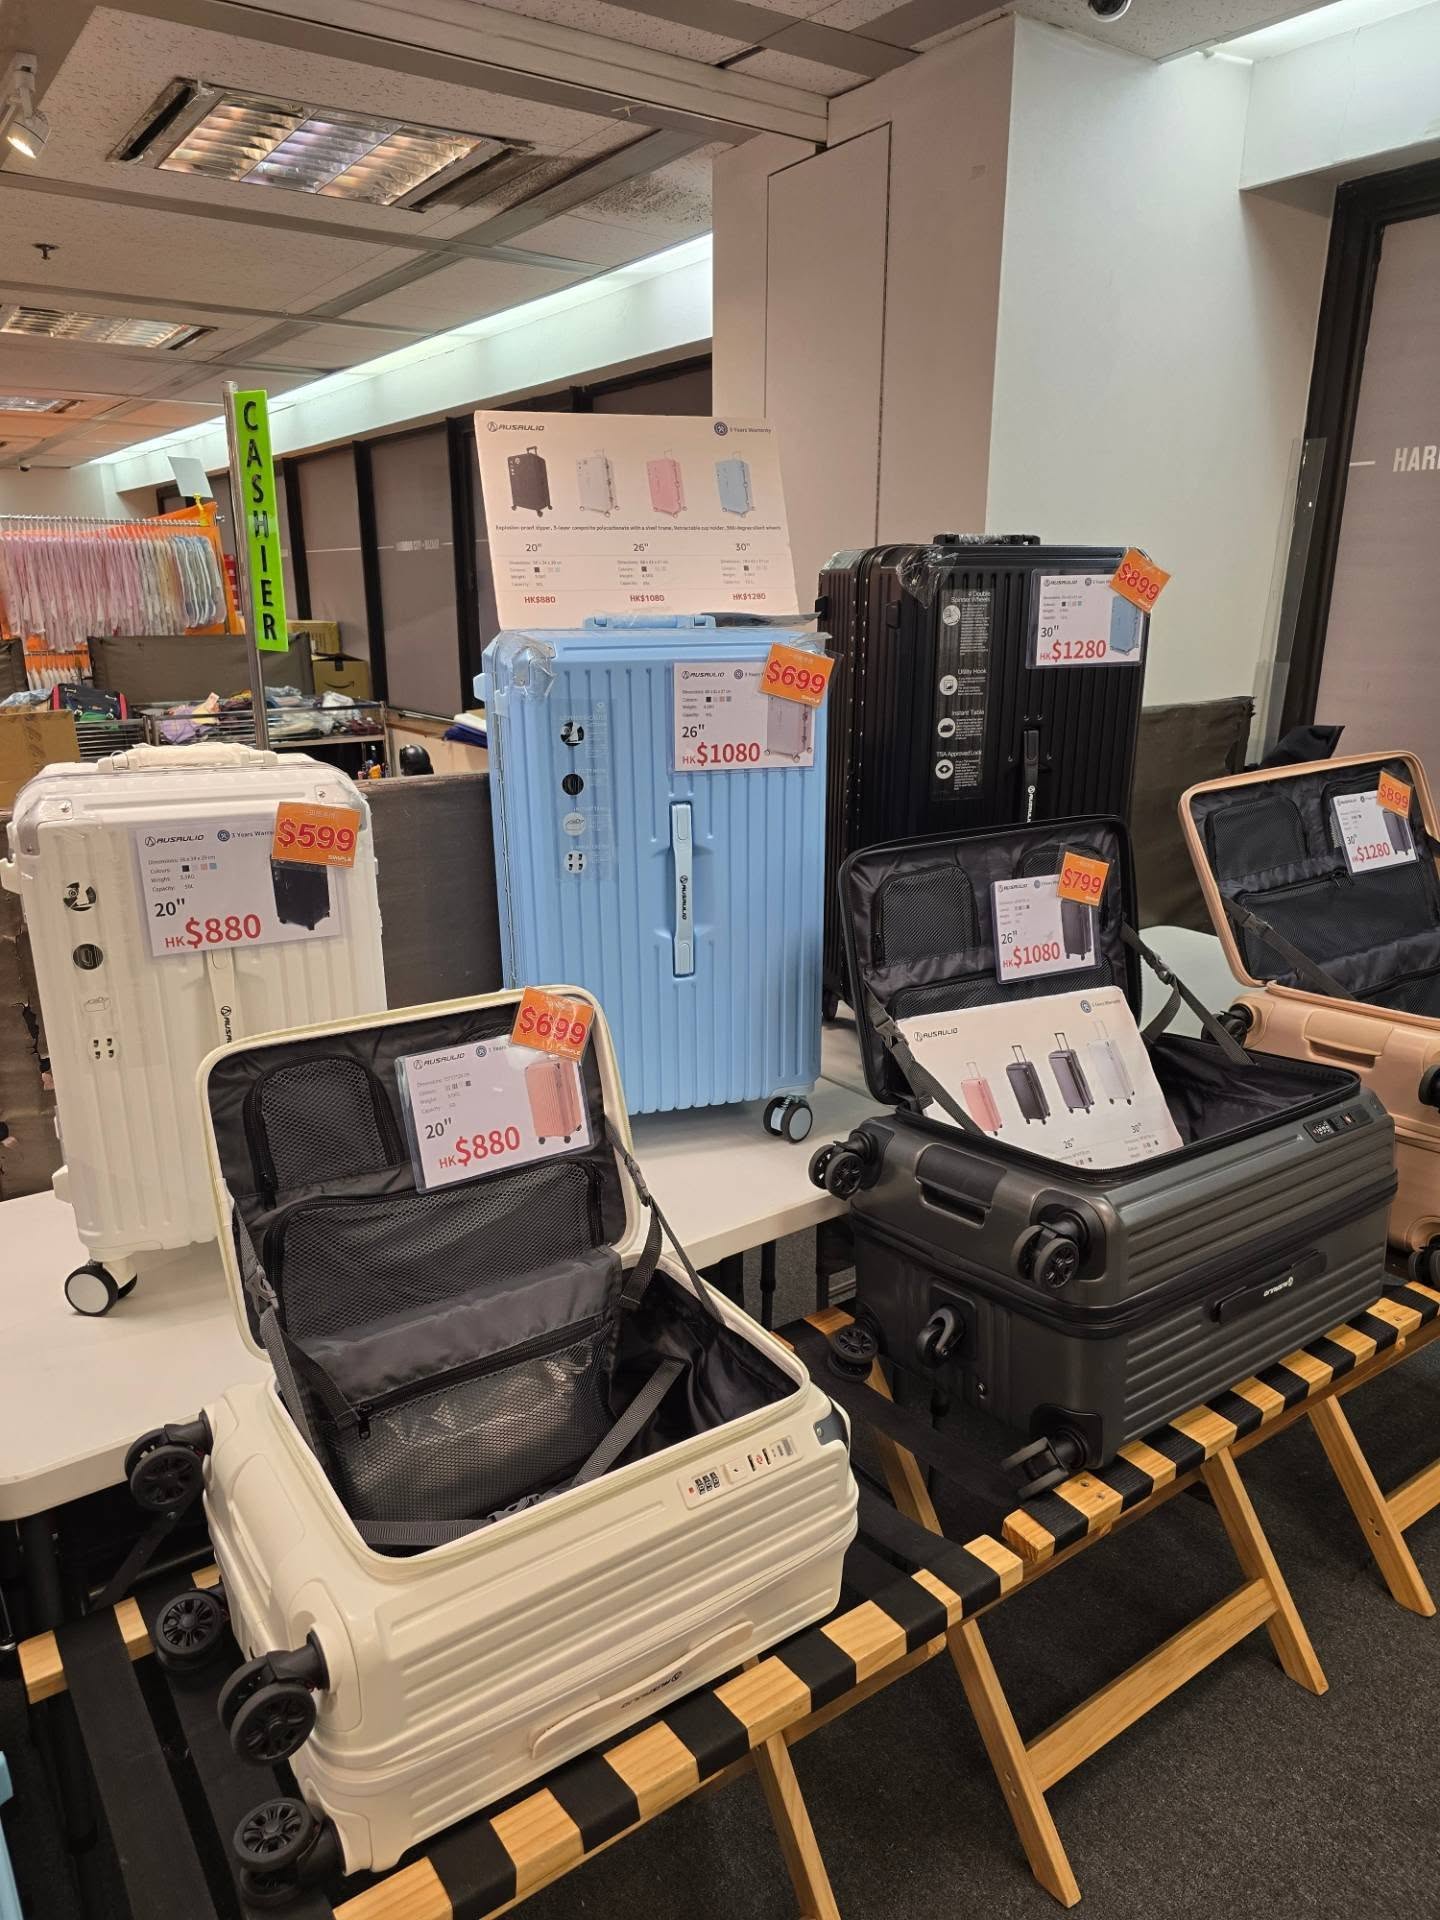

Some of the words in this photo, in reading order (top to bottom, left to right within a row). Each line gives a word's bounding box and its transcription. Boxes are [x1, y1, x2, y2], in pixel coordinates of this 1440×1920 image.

[1392, 445, 1440, 473] HAR
[243, 400, 278, 641] CASHIER
[525, 544, 542, 552] 20"
[633, 543, 649, 552] 26"
[735, 543, 751, 551] 30"
[1118, 562, 1160, 601] $899
[524, 596, 556, 604] HK$880
[732, 592, 767, 601] HK$1280
[1040, 625, 1059, 638] 30"
[1040, 639, 1107, 662] HK$1280
[766, 659, 826, 694] $699
[682, 724, 705, 738] 26"
[682, 741, 761, 767] HK$1080
[1380, 783, 1409, 809] $899
[156, 834, 205, 844] AUSAULIO
[276, 818, 356, 852] $599
[1062, 867, 1102, 894] $799
[154, 898, 185, 918] 20"
[165, 913, 261, 949] HK$880
[1001, 930, 1018, 945] 26"
[1003, 942, 1060, 969] HK$1080
[519, 1005, 586, 1045] $699
[425, 1117, 452, 1140] 20"
[439, 1125, 520, 1169] HK$880
